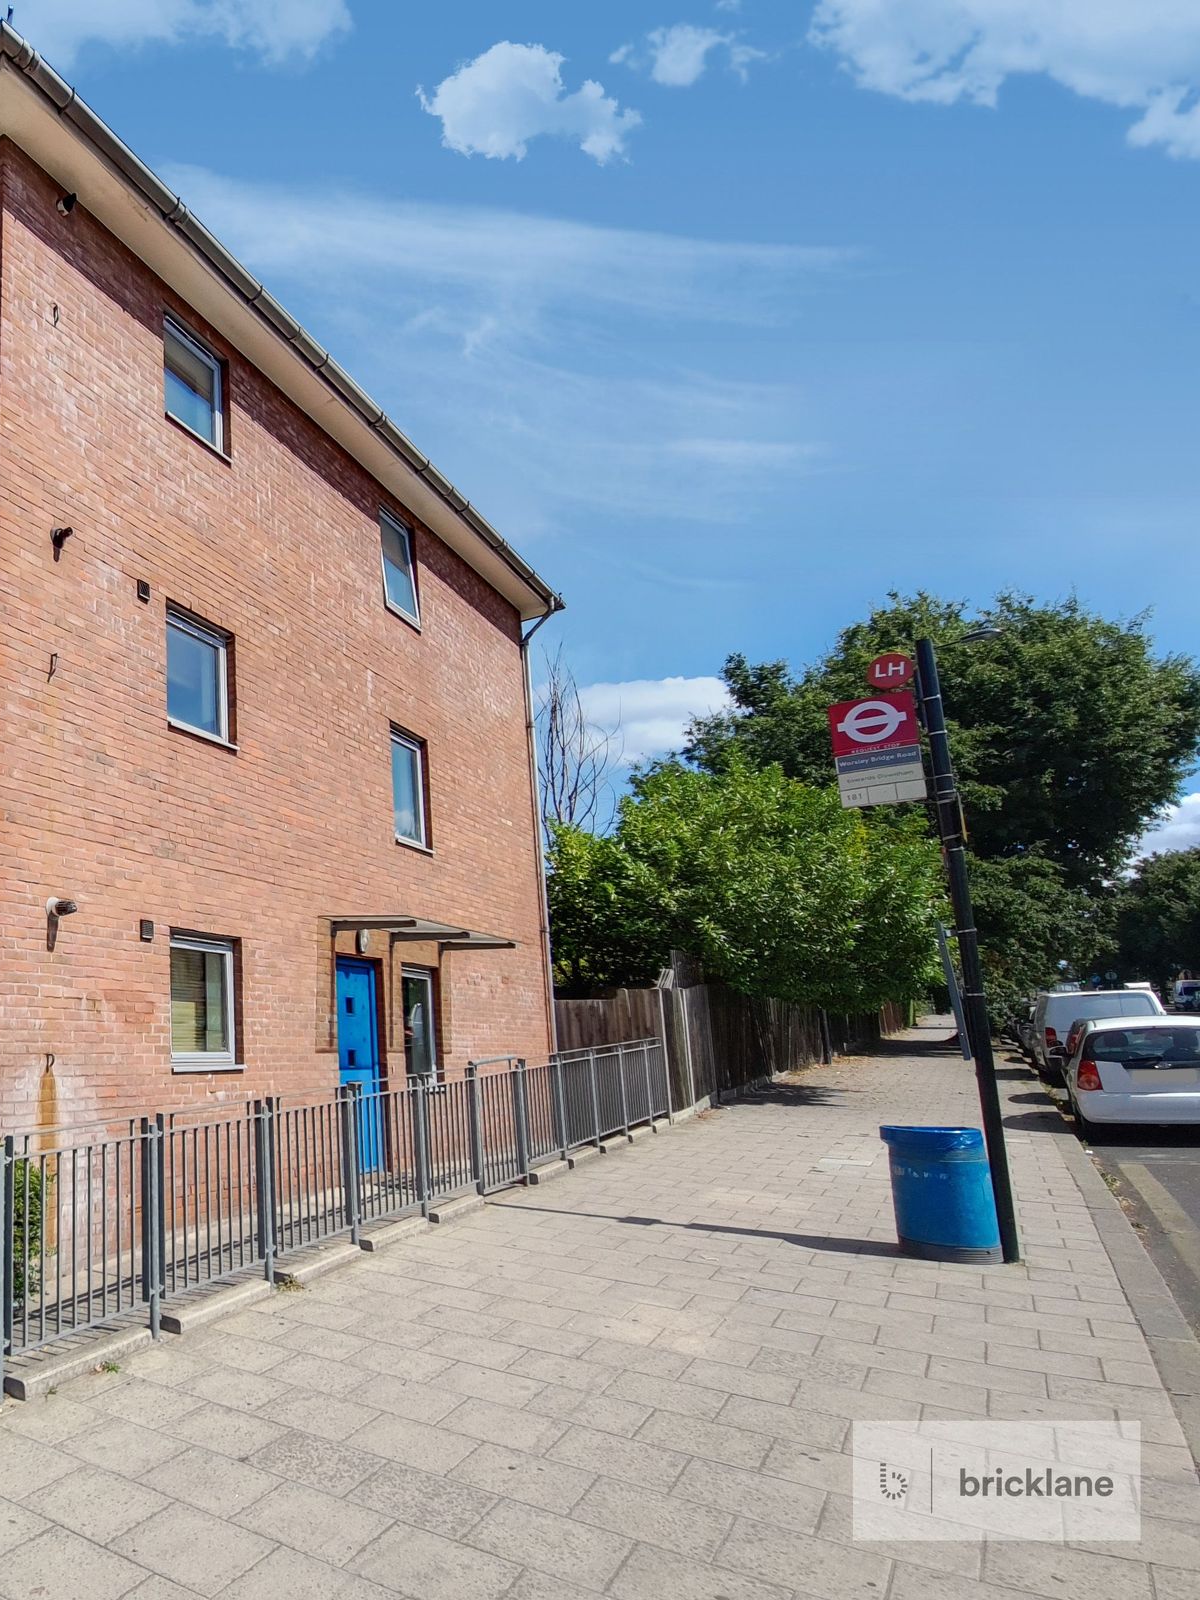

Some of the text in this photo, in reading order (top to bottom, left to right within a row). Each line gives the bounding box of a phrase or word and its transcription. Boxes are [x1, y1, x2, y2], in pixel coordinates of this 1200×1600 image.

[875, 661, 905, 678] LH
[839, 758, 869, 767] Worsley
[871, 754, 895, 762] Bridge
